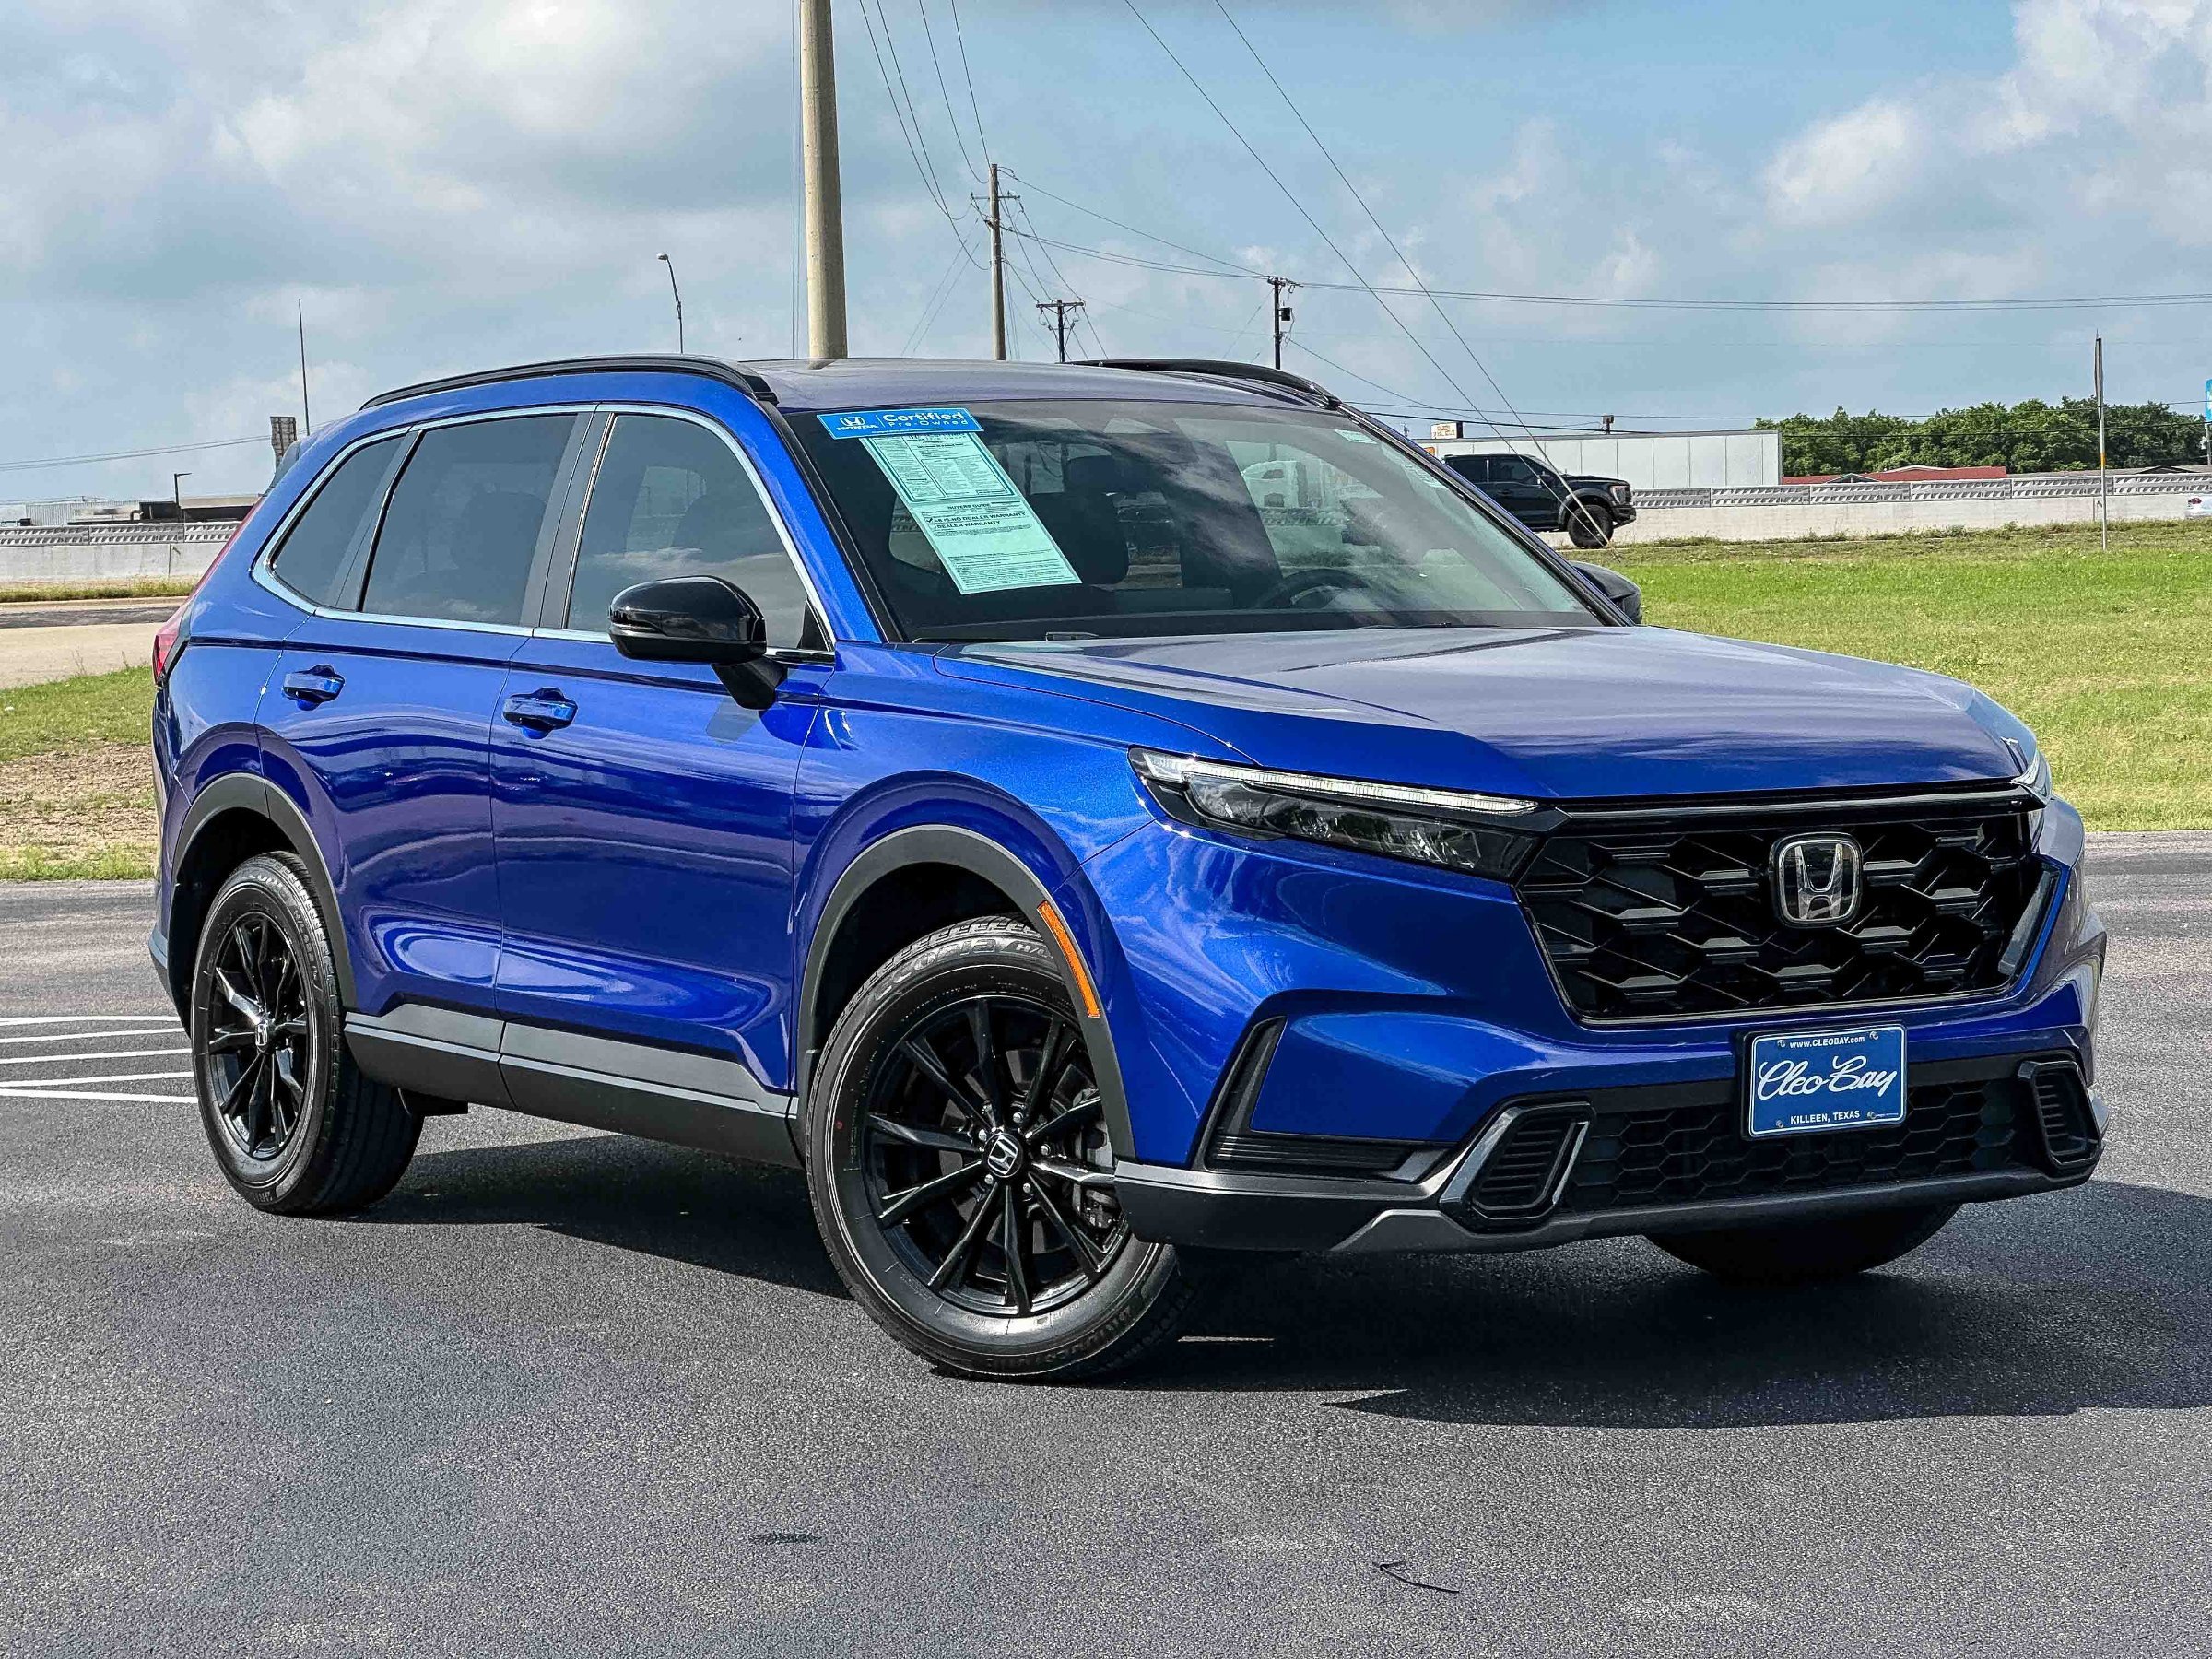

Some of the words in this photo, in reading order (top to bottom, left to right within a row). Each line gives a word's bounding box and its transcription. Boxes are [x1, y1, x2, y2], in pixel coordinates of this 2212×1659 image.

[883, 412, 965, 422] Certified
[888, 419, 969, 428] Pre-Owned
[1790, 1036, 1865, 1048] www.CLEOBAY.com
[1758, 1060, 1829, 1100] Cleo
[1829, 1056, 1897, 1097] Bay
[1790, 1112, 1830, 1125] KILLEEN,
[1832, 1110, 1861, 1122] TEXAS
